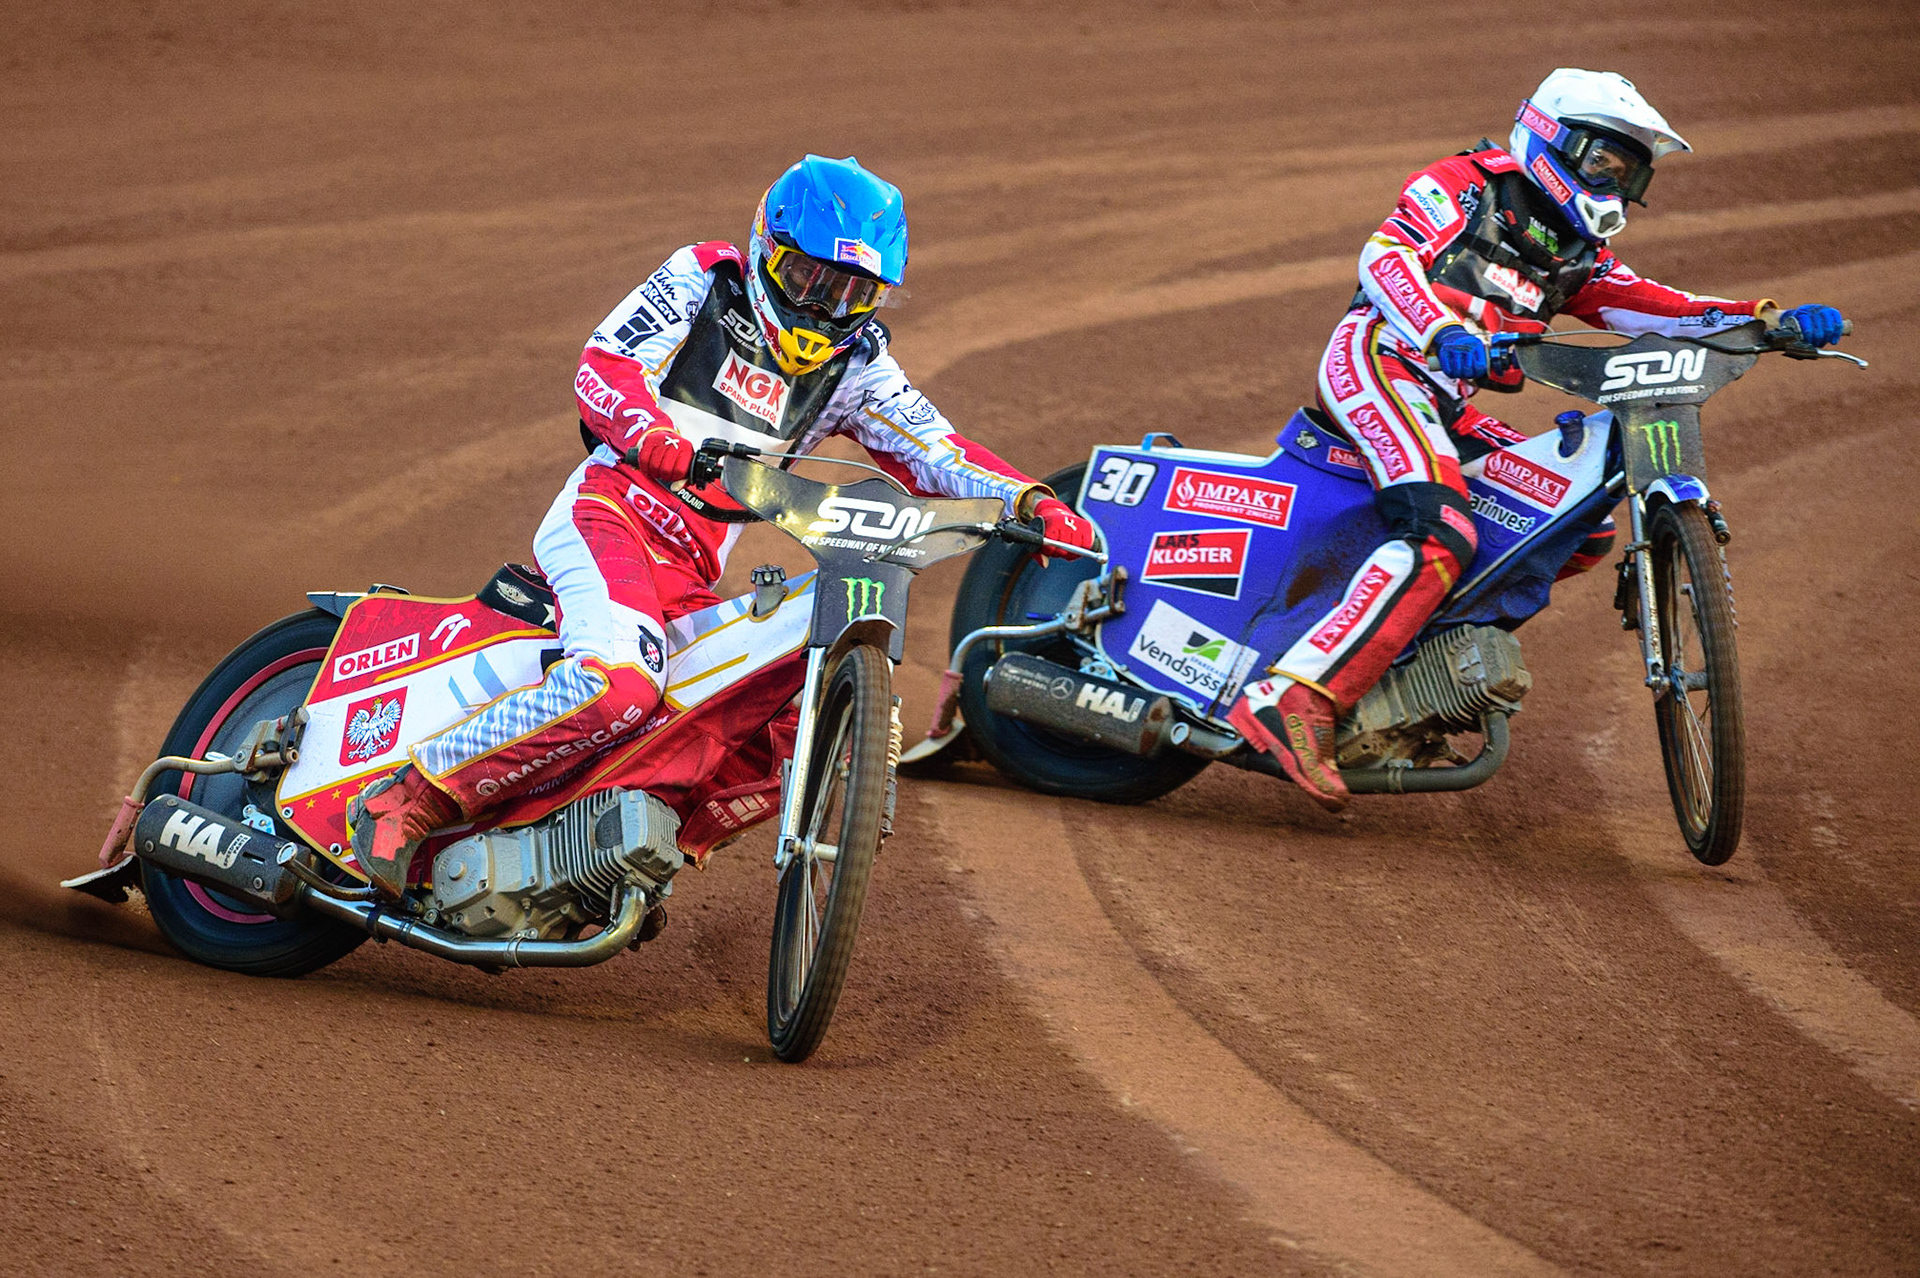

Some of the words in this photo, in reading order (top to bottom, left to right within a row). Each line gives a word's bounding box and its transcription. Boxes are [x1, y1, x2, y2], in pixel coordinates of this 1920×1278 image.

[1387, 266, 1437, 320] IMPAKT
[724, 355, 786, 413] NGK
[1333, 337, 1358, 393] IMPAKT
[719, 381, 749, 411] SPARK
[748, 402, 778, 425] PLUGS
[1366, 416, 1407, 473] IMPAKT
[1088, 456, 1158, 507] 30
[1196, 481, 1287, 511] IMPAKT
[1501, 458, 1566, 497] IMPAKT
[677, 487, 705, 511] POLAND
[1469, 490, 1536, 535] arinvest
[818, 536, 867, 551] SPEEDWAY
[866, 541, 879, 552] OF
[1151, 547, 1233, 565] KLOSTER
[1154, 533, 1201, 549] LARS
[1317, 583, 1374, 649] IMPAKT
[338, 637, 414, 676] ORLEN
[1075, 682, 1147, 724] HAJ
[499, 703, 644, 788] IMMERGAS
[223, 834, 244, 867] SPEEDWAY
[232, 835, 249, 855] PARTS
